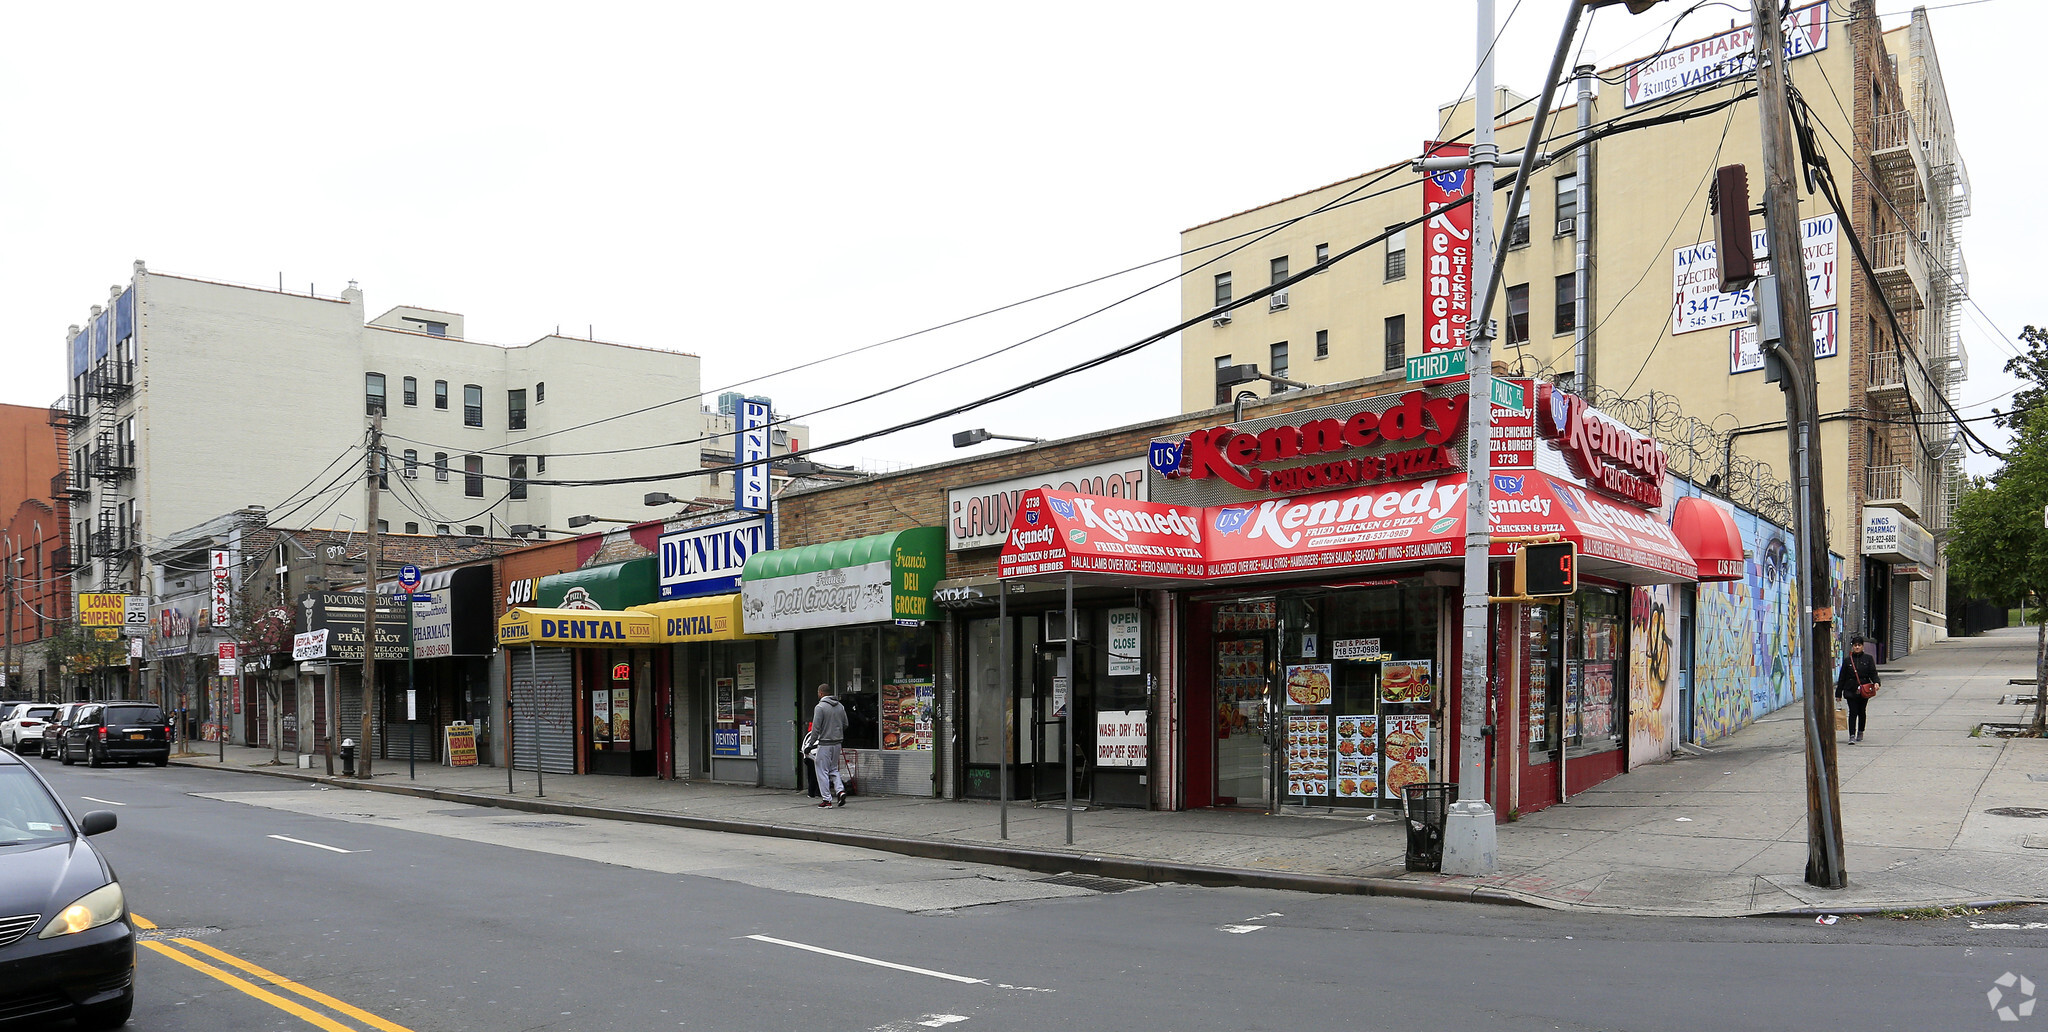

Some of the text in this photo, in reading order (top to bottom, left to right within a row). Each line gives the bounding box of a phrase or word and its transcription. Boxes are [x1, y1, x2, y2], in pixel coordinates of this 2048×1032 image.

[1643, 56, 1746, 98] Kings VARIETY
[1451, 247, 1467, 310] CHICKEN
[1451, 314, 1467, 323] &
[1690, 315, 1706, 327] 545
[1409, 351, 1465, 379] THIRD AV
[1495, 381, 1512, 406] PAULS
[1516, 390, 1522, 400] PL
[1490, 405, 1533, 424] ennedy
[1154, 390, 1469, 491] US Kennedy
[1490, 426, 1532, 438] RIED CHICKEN
[1502, 440, 1533, 452] & BURGER
[1553, 394, 1669, 488] US Kennedy
[747, 404, 763, 508] DENTIST
[1498, 454, 1519, 464] 3738
[1269, 457, 1360, 493] CHICKEN
[1384, 445, 1450, 477] PIZZA
[1498, 479, 1517, 489] US
[1026, 497, 1040, 509] 3738
[1489, 495, 1552, 525] ennedy
[1053, 498, 1201, 544] US Kennedy
[1219, 479, 1468, 549] US Kennedy
[1567, 485, 1679, 549] Kennedy
[1871, 516, 1889, 525] KINGS
[1305, 526, 1335, 538] FRIED
[1336, 520, 1381, 534] CHICKEN
[1393, 516, 1424, 528] PIZZA
[1495, 524, 1532, 533] CHICKEN
[1533, 524, 1540, 532] &
[1541, 524, 1566, 532] PIZZA
[1866, 525, 1897, 534] PHARMACY
[1012, 524, 1055, 551] Kennedy
[662, 525, 763, 579] DENTIST
[895, 547, 927, 569] Francis
[1001, 554, 1017, 565] FRIED
[1018, 552, 1042, 563] CHICKEN
[1049, 548, 1066, 559] PIZZA
[1094, 541, 1124, 553] FRIED
[1125, 544, 1166, 556] CHICKEN
[1174, 547, 1202, 558] PIZZA
[1002, 561, 1064, 576] HOT WINGS HEROES
[1071, 556, 1204, 576] HALAL LAMB OVER RICE HERO SANDWICH SALAD
[1560, 555, 1572, 586] 9
[1718, 560, 1728, 574] US
[904, 572, 919, 591] DELI
[88, 594, 122, 608] LOANS
[324, 594, 364, 605] DOCTORS
[774, 585, 860, 616] Deli Grocery
[895, 594, 927, 616] GROCERY
[81, 610, 124, 624] EMPEÑO
[128, 612, 146, 622] 25
[1110, 613, 1138, 624] OPEN
[414, 623, 450, 641] PHARMACY
[502, 624, 530, 638] DENTAL
[541, 620, 650, 640] DENTAL KDM
[667, 616, 727, 637] DENTAL KDM
[1113, 638, 1136, 650] CLOSE
[1305, 638, 1314, 651] A
[1334, 646, 1380, 656] 718 537-0989
[1355, 639, 1379, 647] Pick-up
[1099, 723, 1147, 737] WASH DRY FOL
[716, 733, 738, 746] DENTIST
[1098, 744, 1126, 758] DROP-OFF
